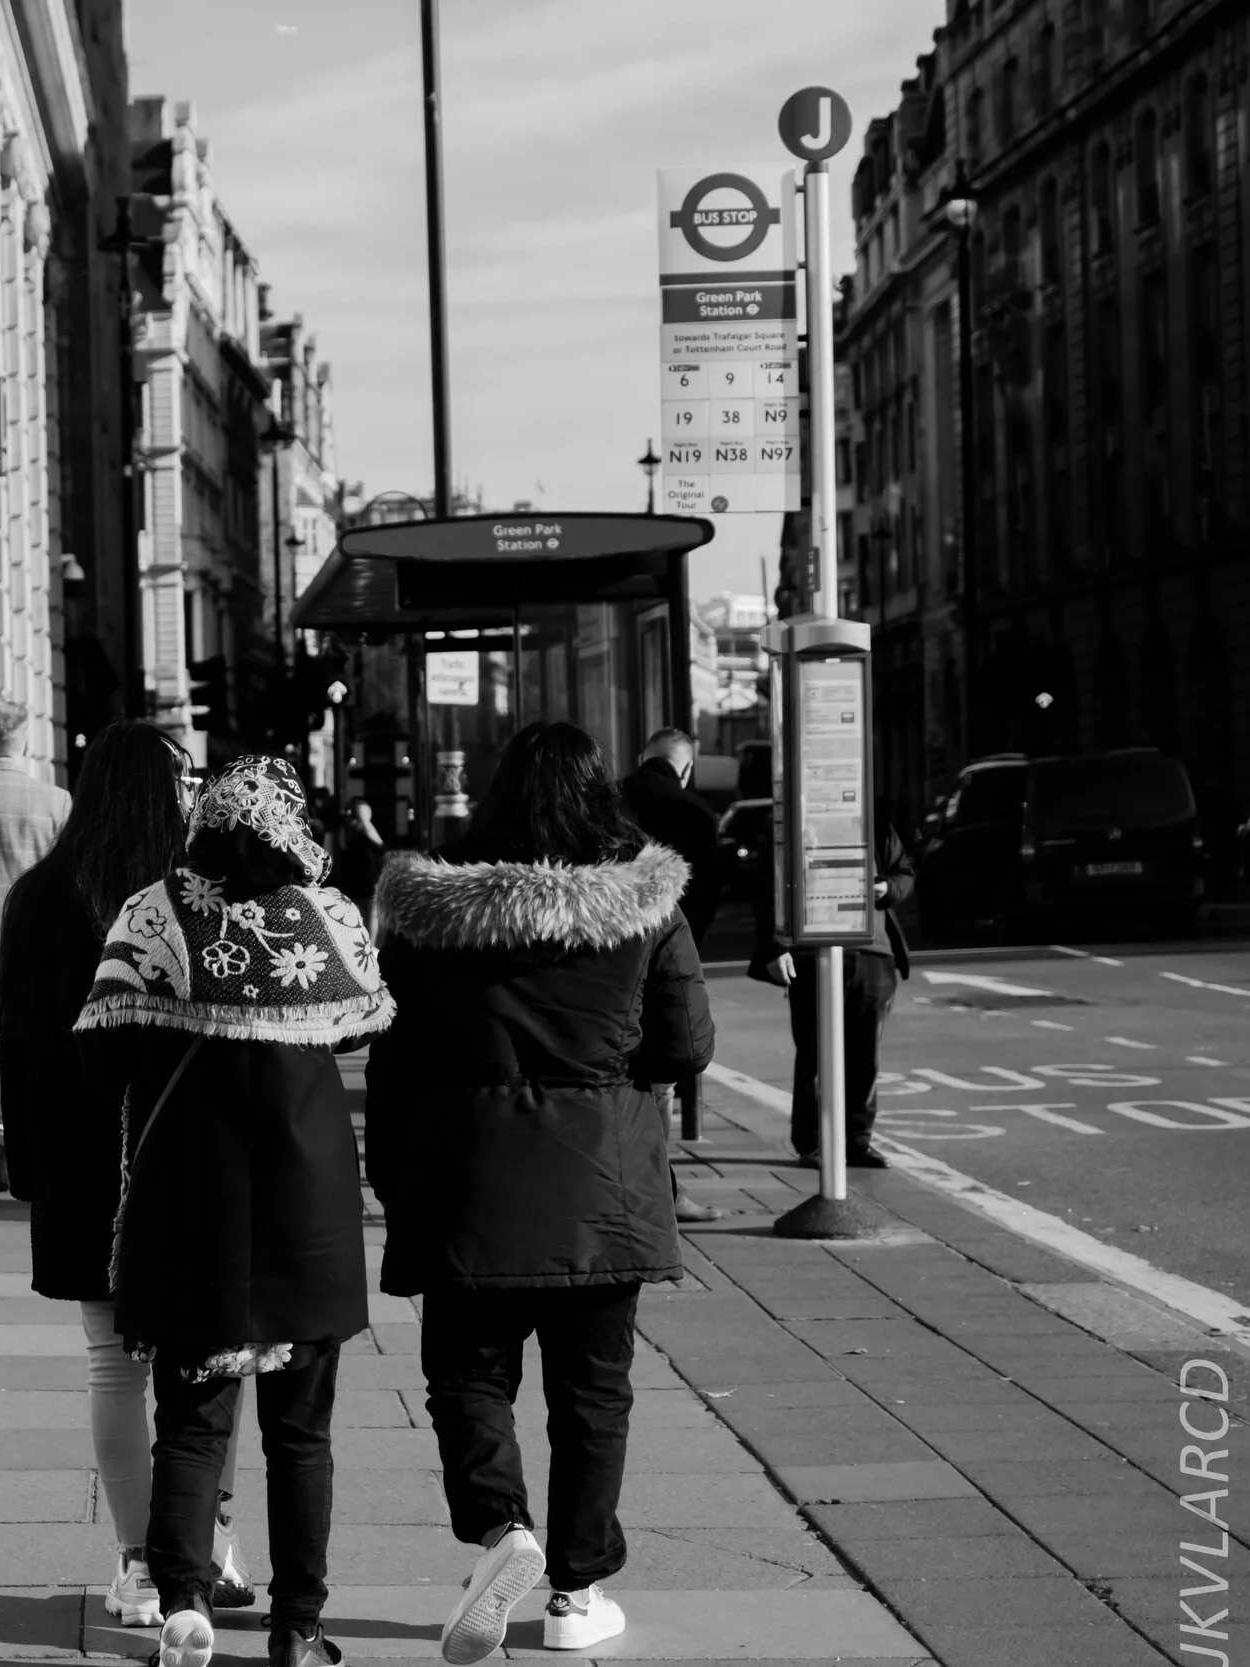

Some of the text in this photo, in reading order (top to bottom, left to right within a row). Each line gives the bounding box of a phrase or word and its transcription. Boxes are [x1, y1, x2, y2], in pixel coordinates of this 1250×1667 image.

[800, 97, 831, 150] J
[694, 209, 758, 224] BUS STOP
[696, 290, 763, 303] Green Park
[700, 305, 743, 317] Station
[674, 331, 785, 342] towards Trafalgar Square
[685, 344, 734, 354] Tottenham
[737, 343, 762, 352] Court
[764, 343, 787, 352] Road
[680, 373, 690, 387] 6
[725, 372, 735, 386] 9
[768, 371, 785, 384] 14
[676, 411, 693, 425] 19
[721, 410, 741, 424] 38
[764, 409, 788, 423] N9
[670, 449, 702, 463] N19
[716, 447, 748, 461] N38
[761, 447, 793, 460] N97
[678, 480, 696, 488] The
[668, 490, 705, 500] Original
[676, 500, 697, 509] Tour
[493, 522, 563, 536] Green Park
[497, 539, 543, 551] Station
[876, 1097, 1250, 1140] STO
